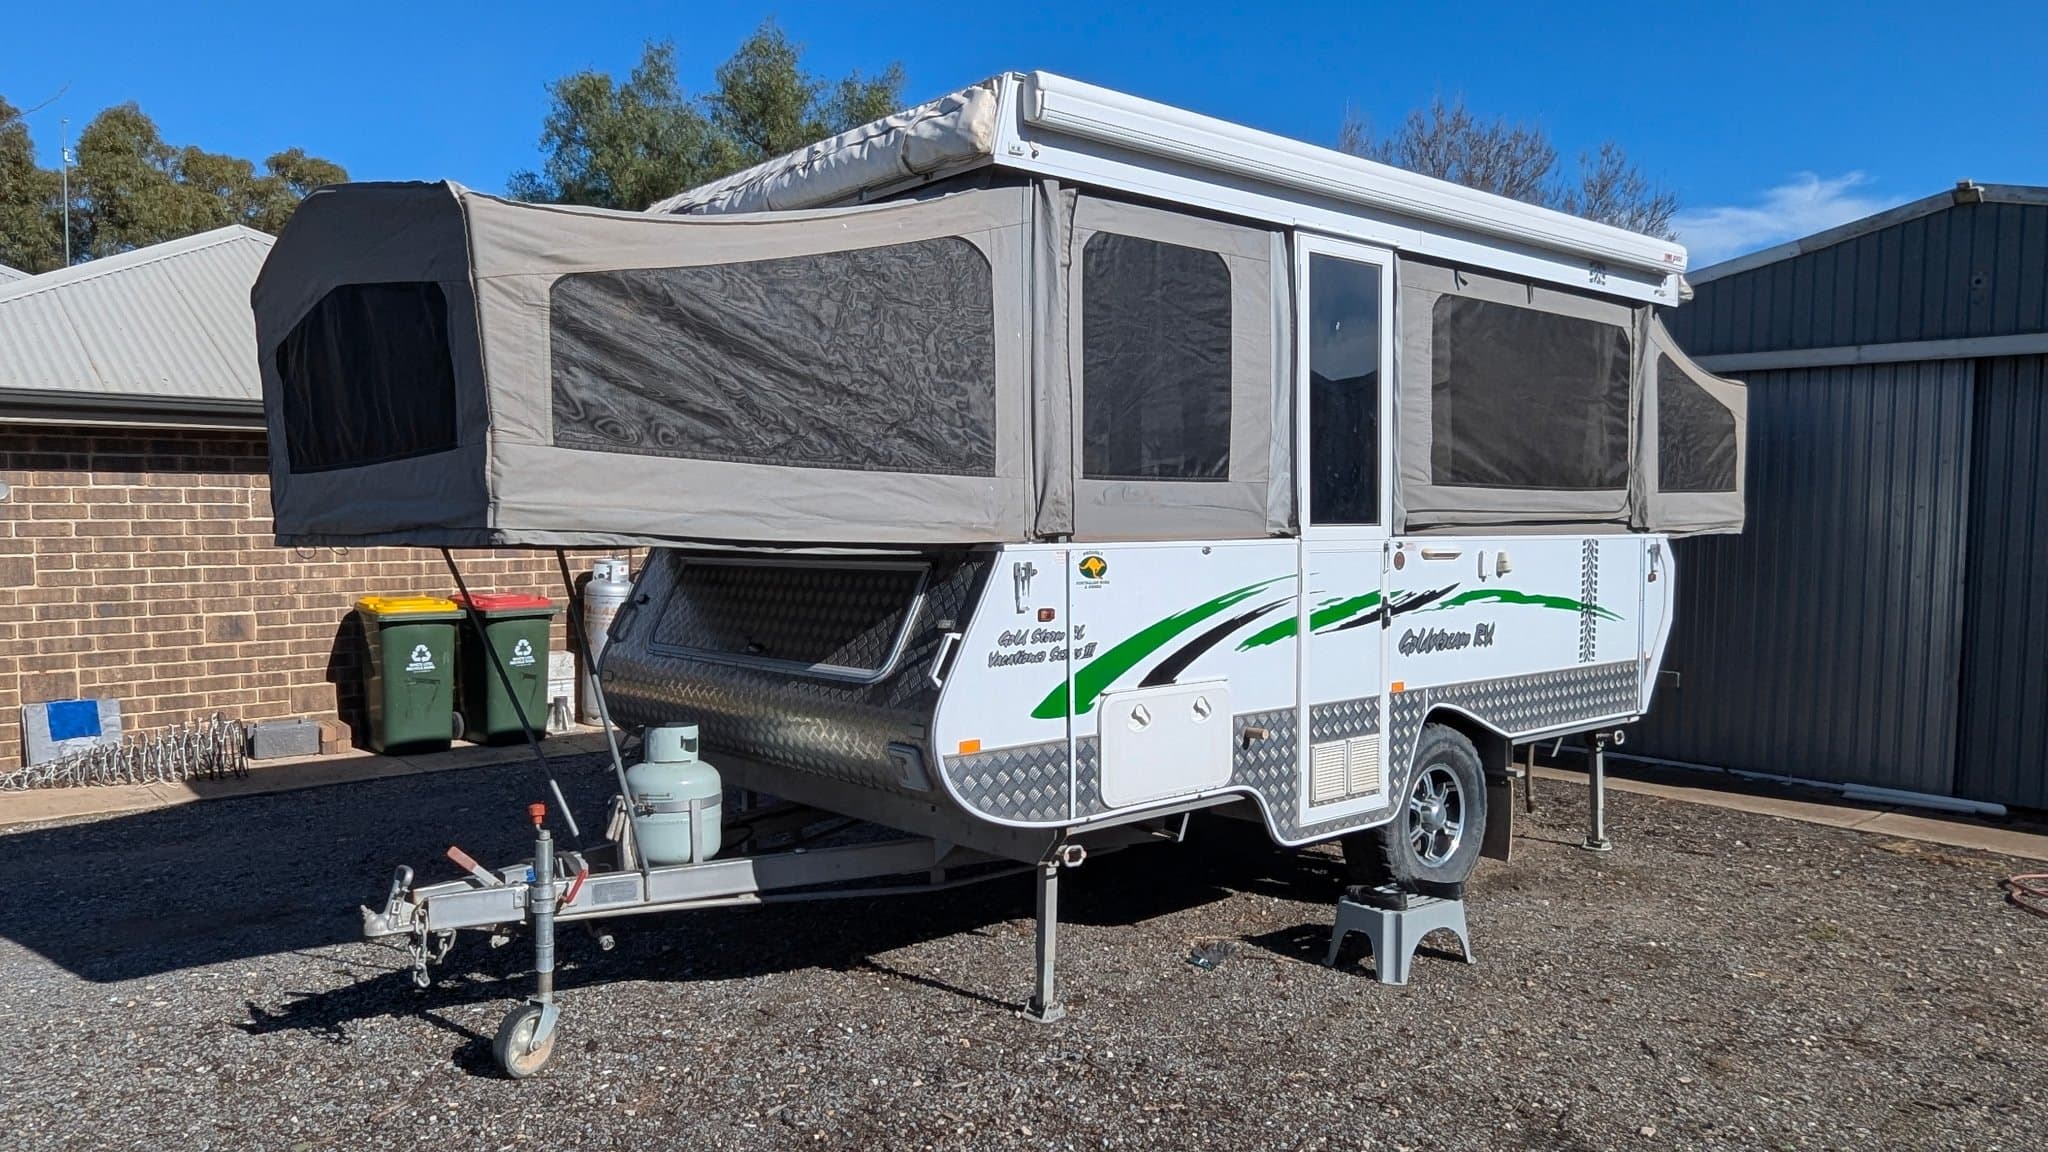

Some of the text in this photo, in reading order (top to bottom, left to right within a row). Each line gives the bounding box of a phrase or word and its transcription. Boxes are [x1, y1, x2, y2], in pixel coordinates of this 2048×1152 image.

[998, 629, 1030, 648] Gold
[1473, 621, 1496, 647] RV
[988, 649, 1047, 668] Vacationer
